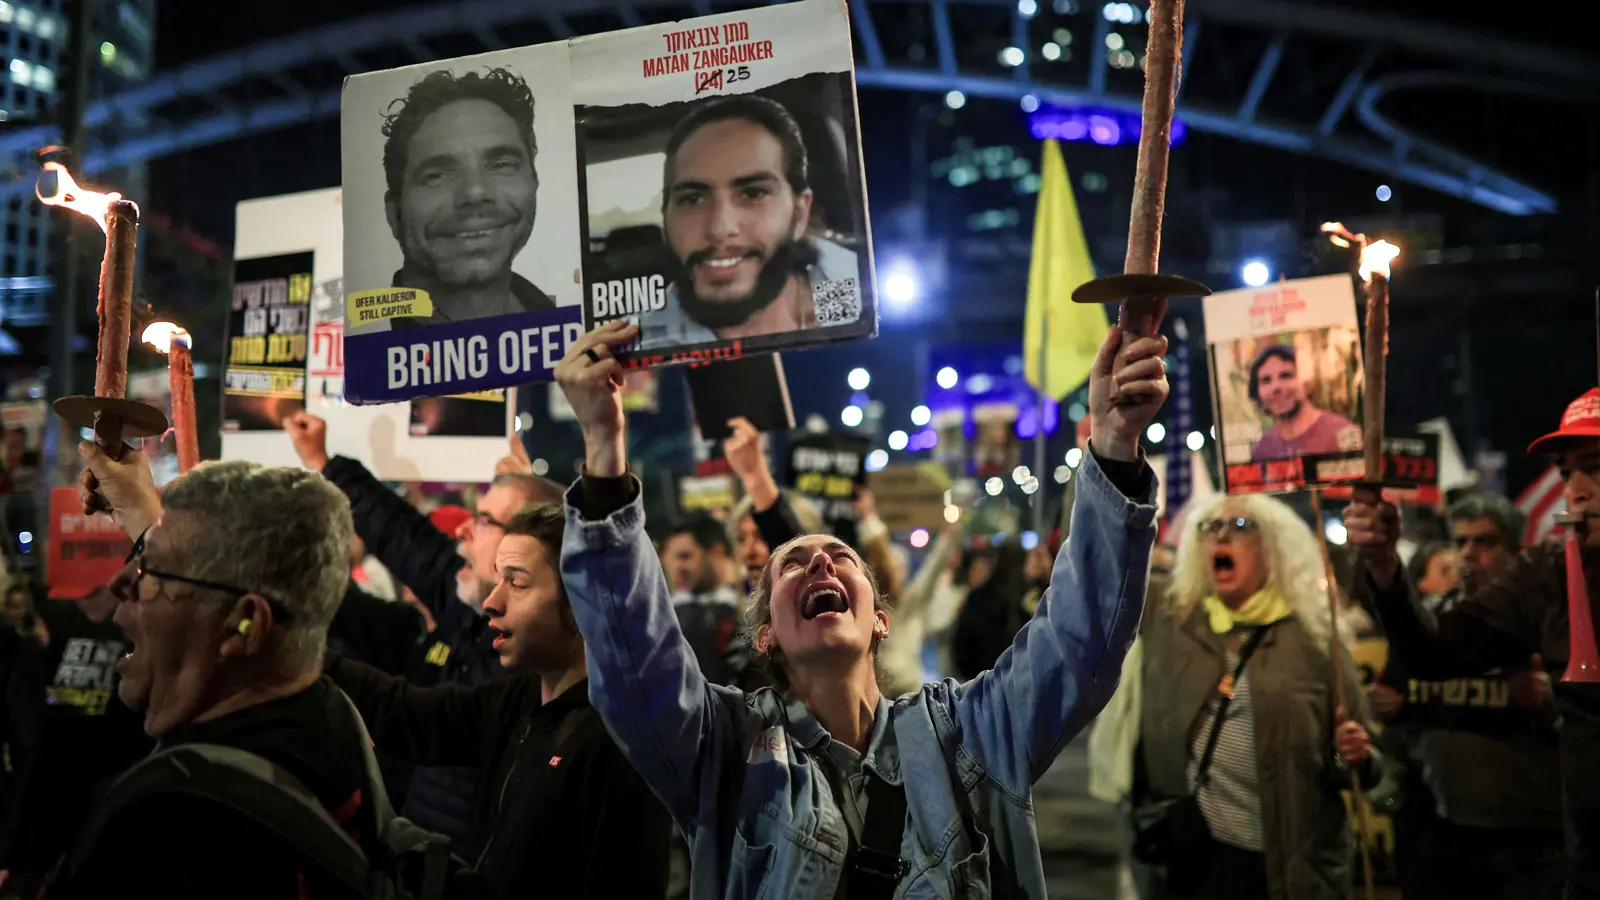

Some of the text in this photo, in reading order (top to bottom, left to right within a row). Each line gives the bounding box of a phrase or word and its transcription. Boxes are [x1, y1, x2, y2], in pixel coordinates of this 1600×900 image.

[663, 21, 749, 54] מתן צנגאוקר
[643, 40, 774, 78] MATAN ZANGAUKER
[726, 66, 751, 84] 25
[355, 290, 417, 308] OFER KALDERON
[591, 273, 665, 318] BRING
[359, 304, 413, 321] STILL CAPTIVE
[387, 334, 488, 390] BRING
[1407, 678, 1509, 708] עכשיו!
